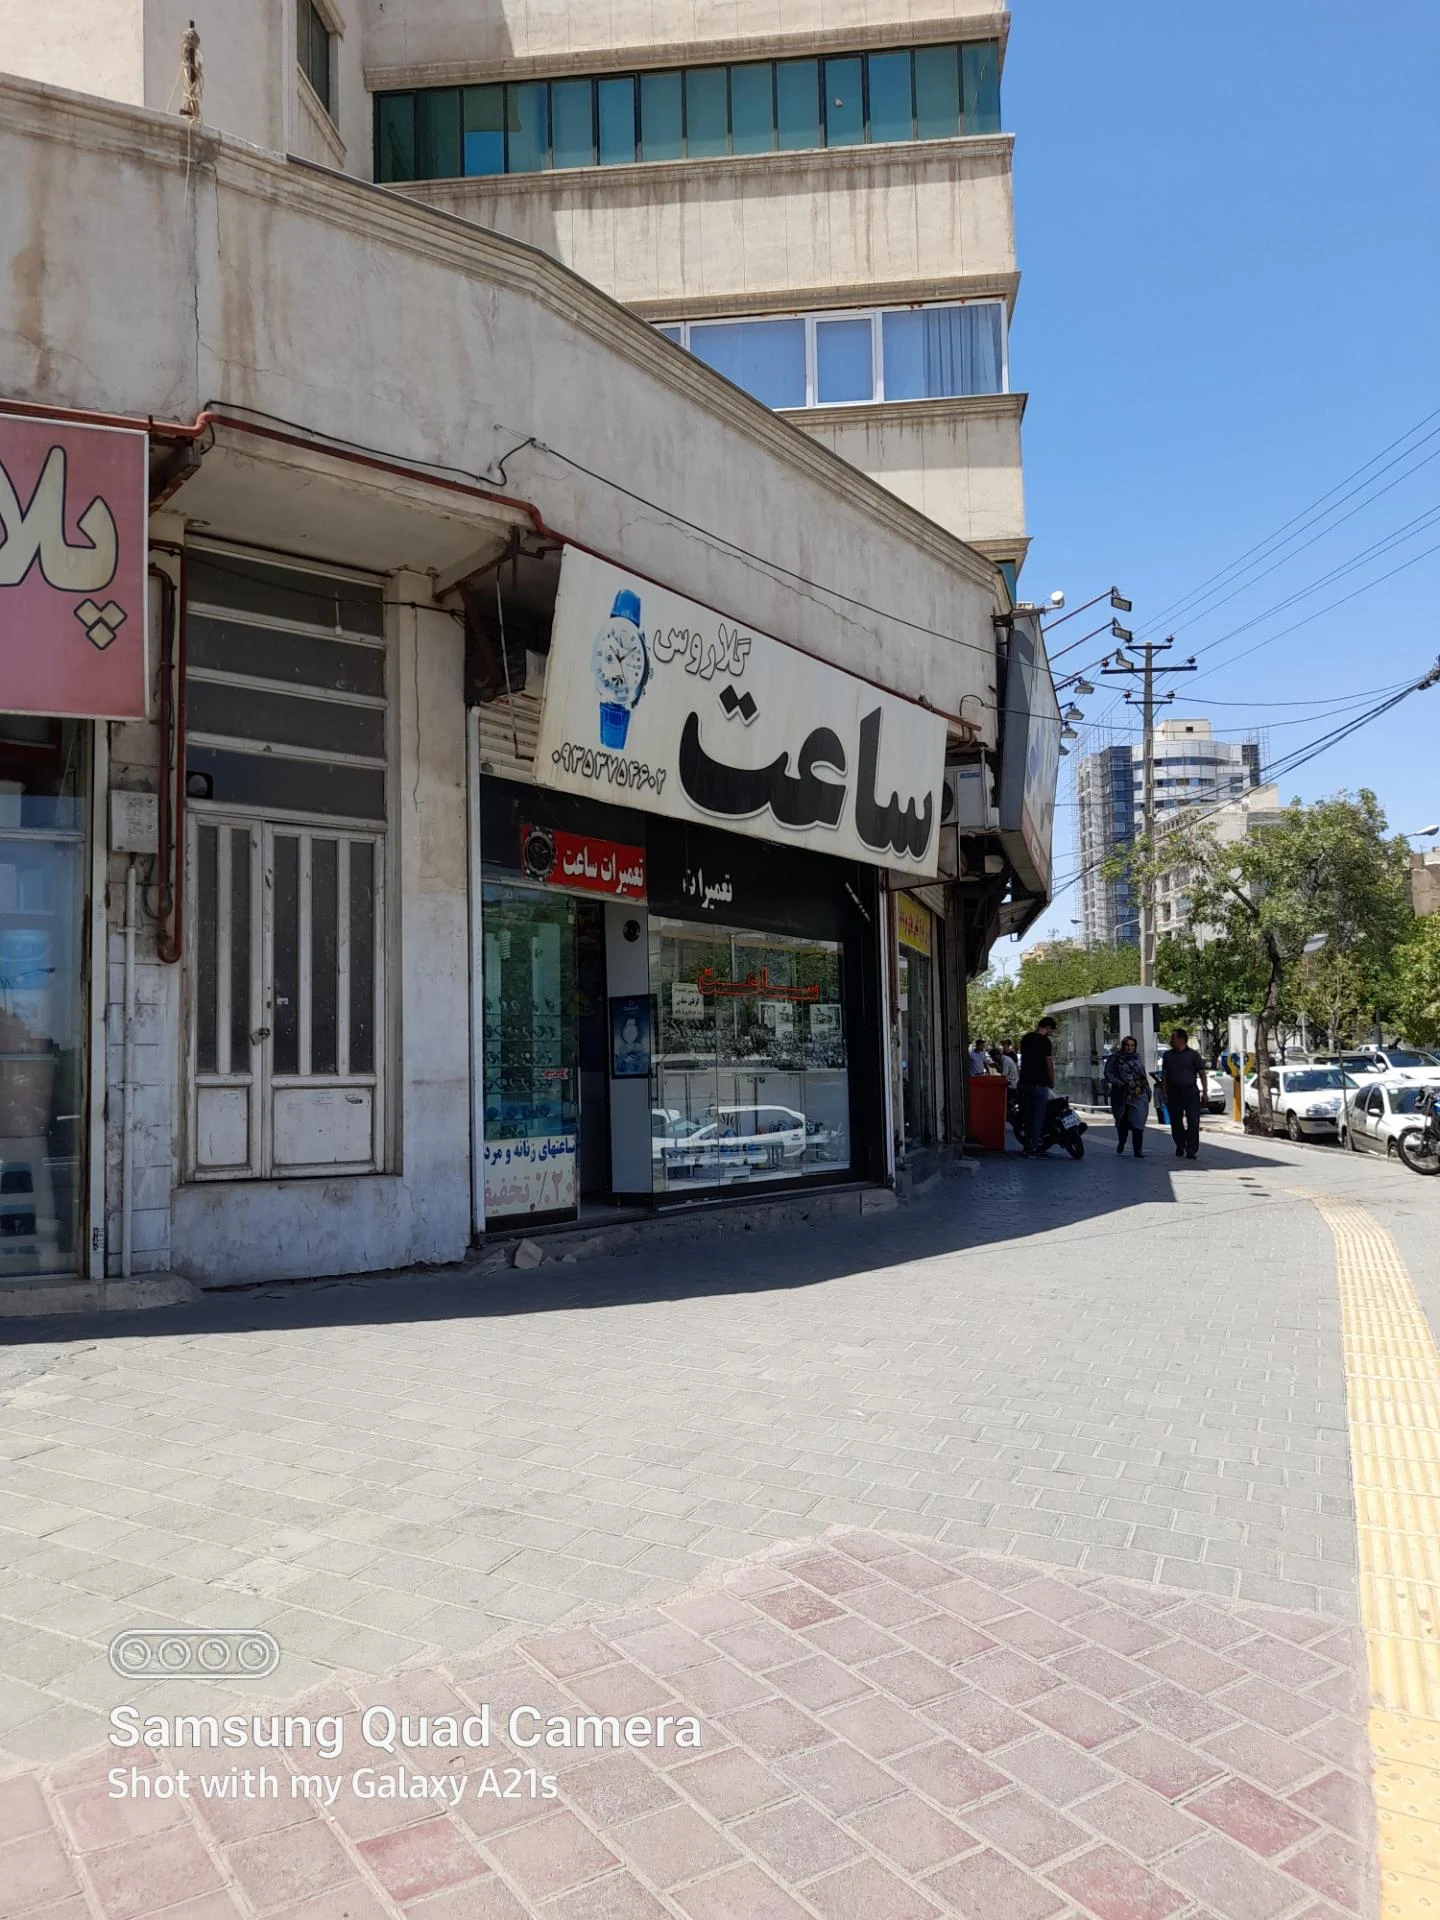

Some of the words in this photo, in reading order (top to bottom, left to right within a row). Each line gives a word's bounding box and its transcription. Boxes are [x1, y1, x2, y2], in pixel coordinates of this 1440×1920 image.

[653, 622, 752, 681] گلاروس
[551, 742, 667, 796] ۰۹۳۵۳۷۵۴۶۰۲
[679, 684, 933, 860] ساعت
[562, 846, 598, 879] ساعت
[600, 852, 644, 895] تعمیرات
[503, 1147, 512, 1165] و
[513, 1138, 543, 1163] زنانه
